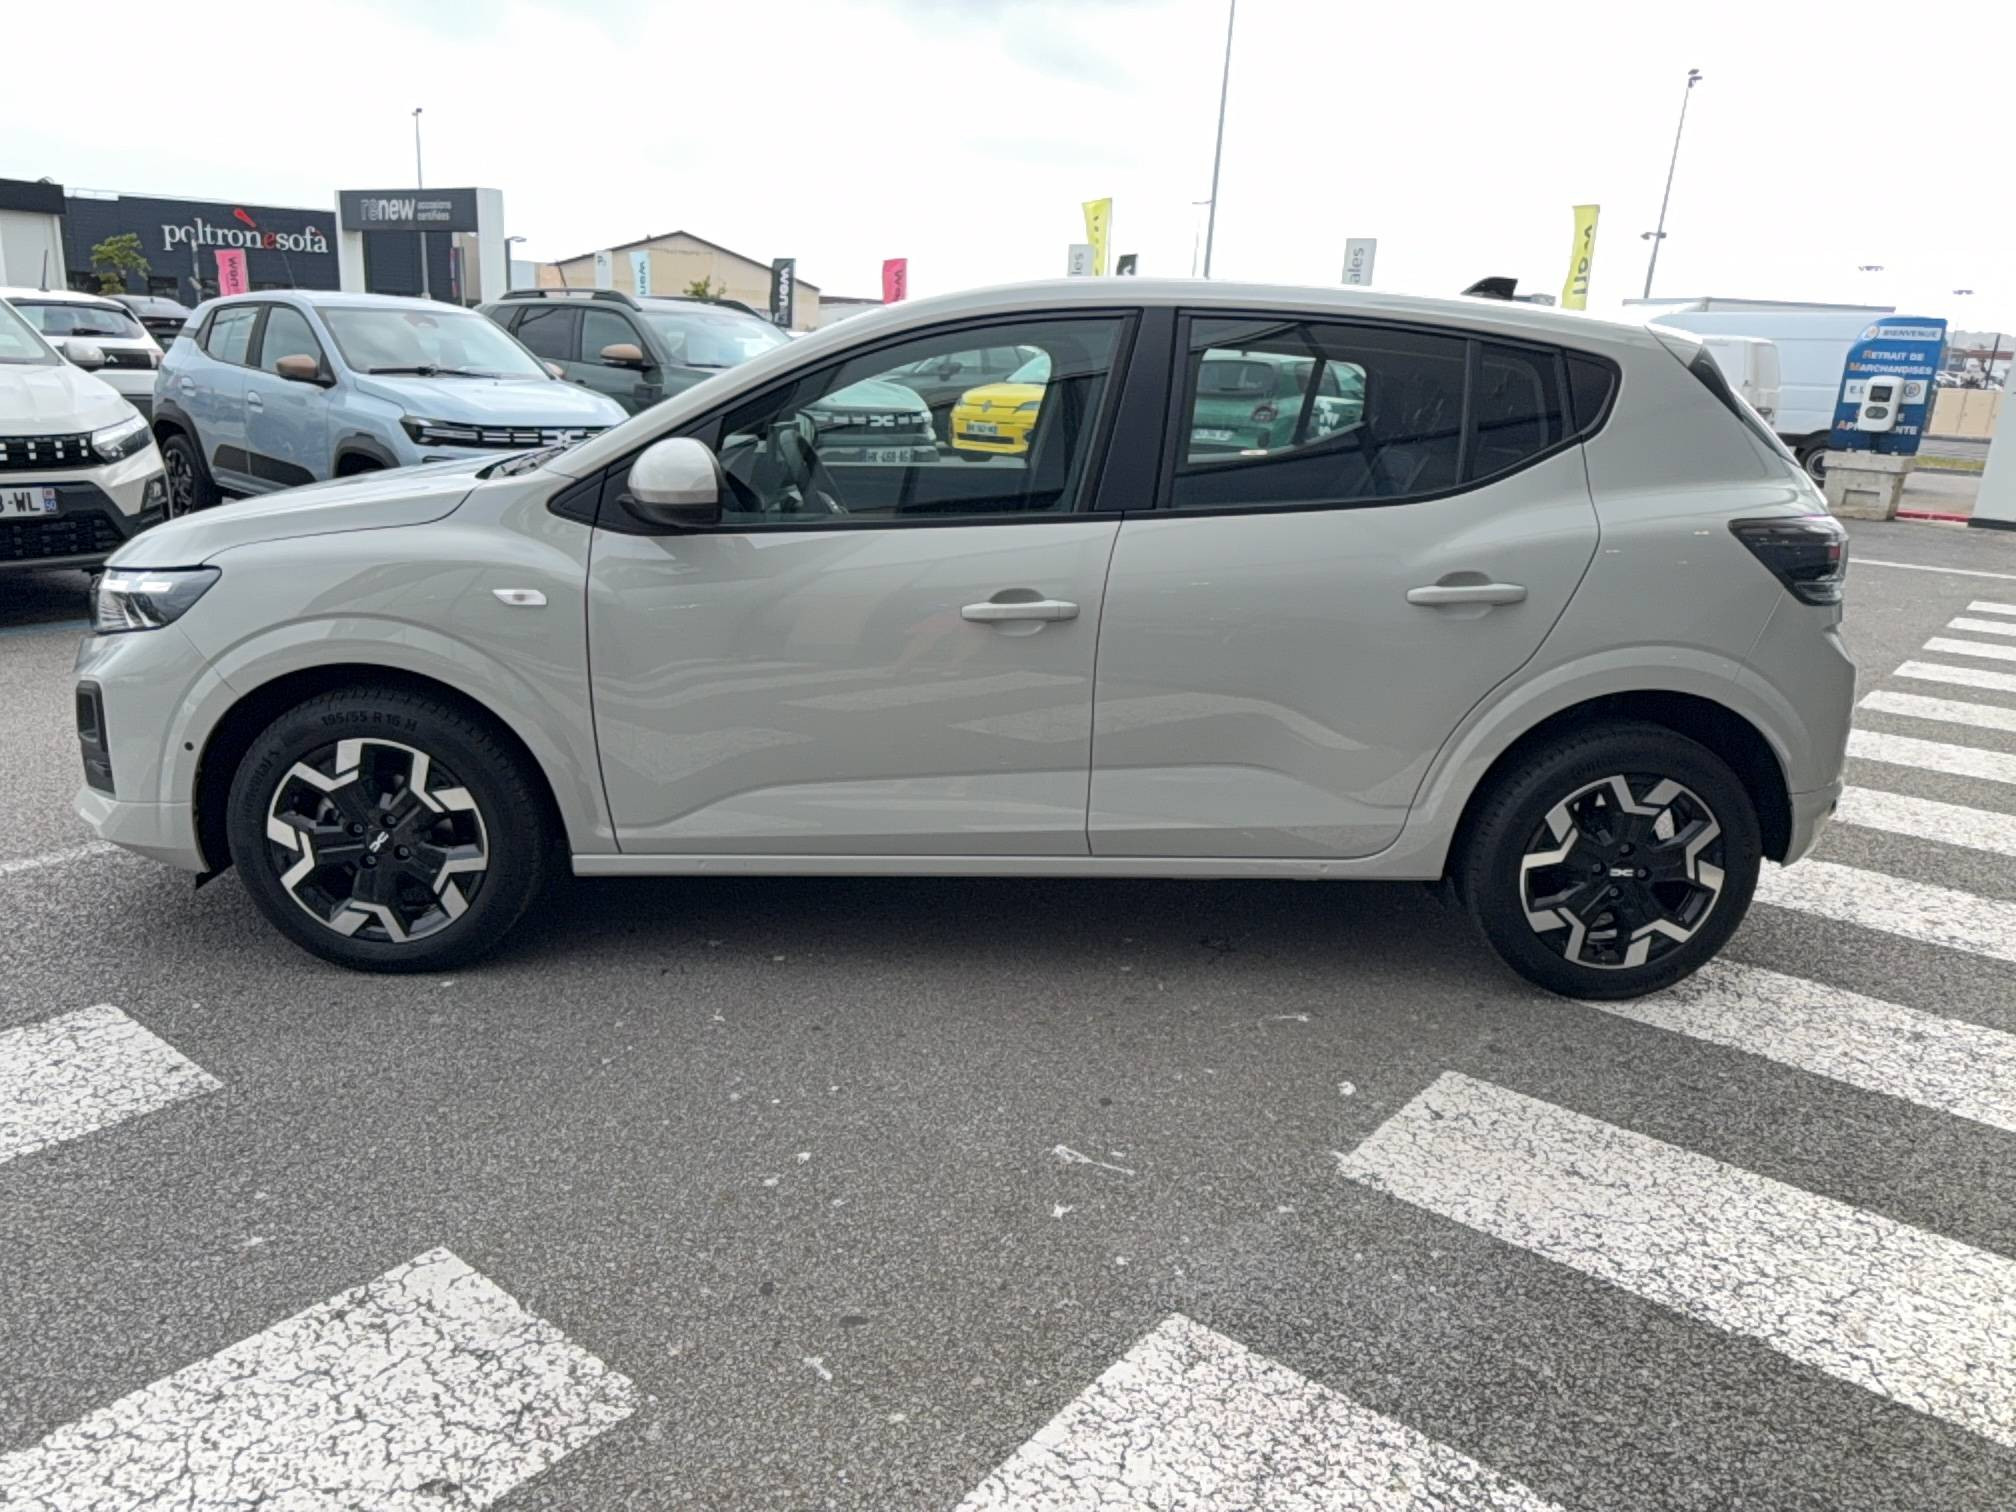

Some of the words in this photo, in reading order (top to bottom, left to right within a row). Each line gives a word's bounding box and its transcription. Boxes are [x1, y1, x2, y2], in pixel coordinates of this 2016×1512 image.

[360, 198, 415, 220] renew
[1882, 329, 1938, 338] BIENVENUE
[1862, 350, 1906, 361] RETRAIT
[1908, 352, 1925, 361] DE
[1849, 362, 1933, 375] MARCHANDISES
[321, 711, 369, 727] 195/55
